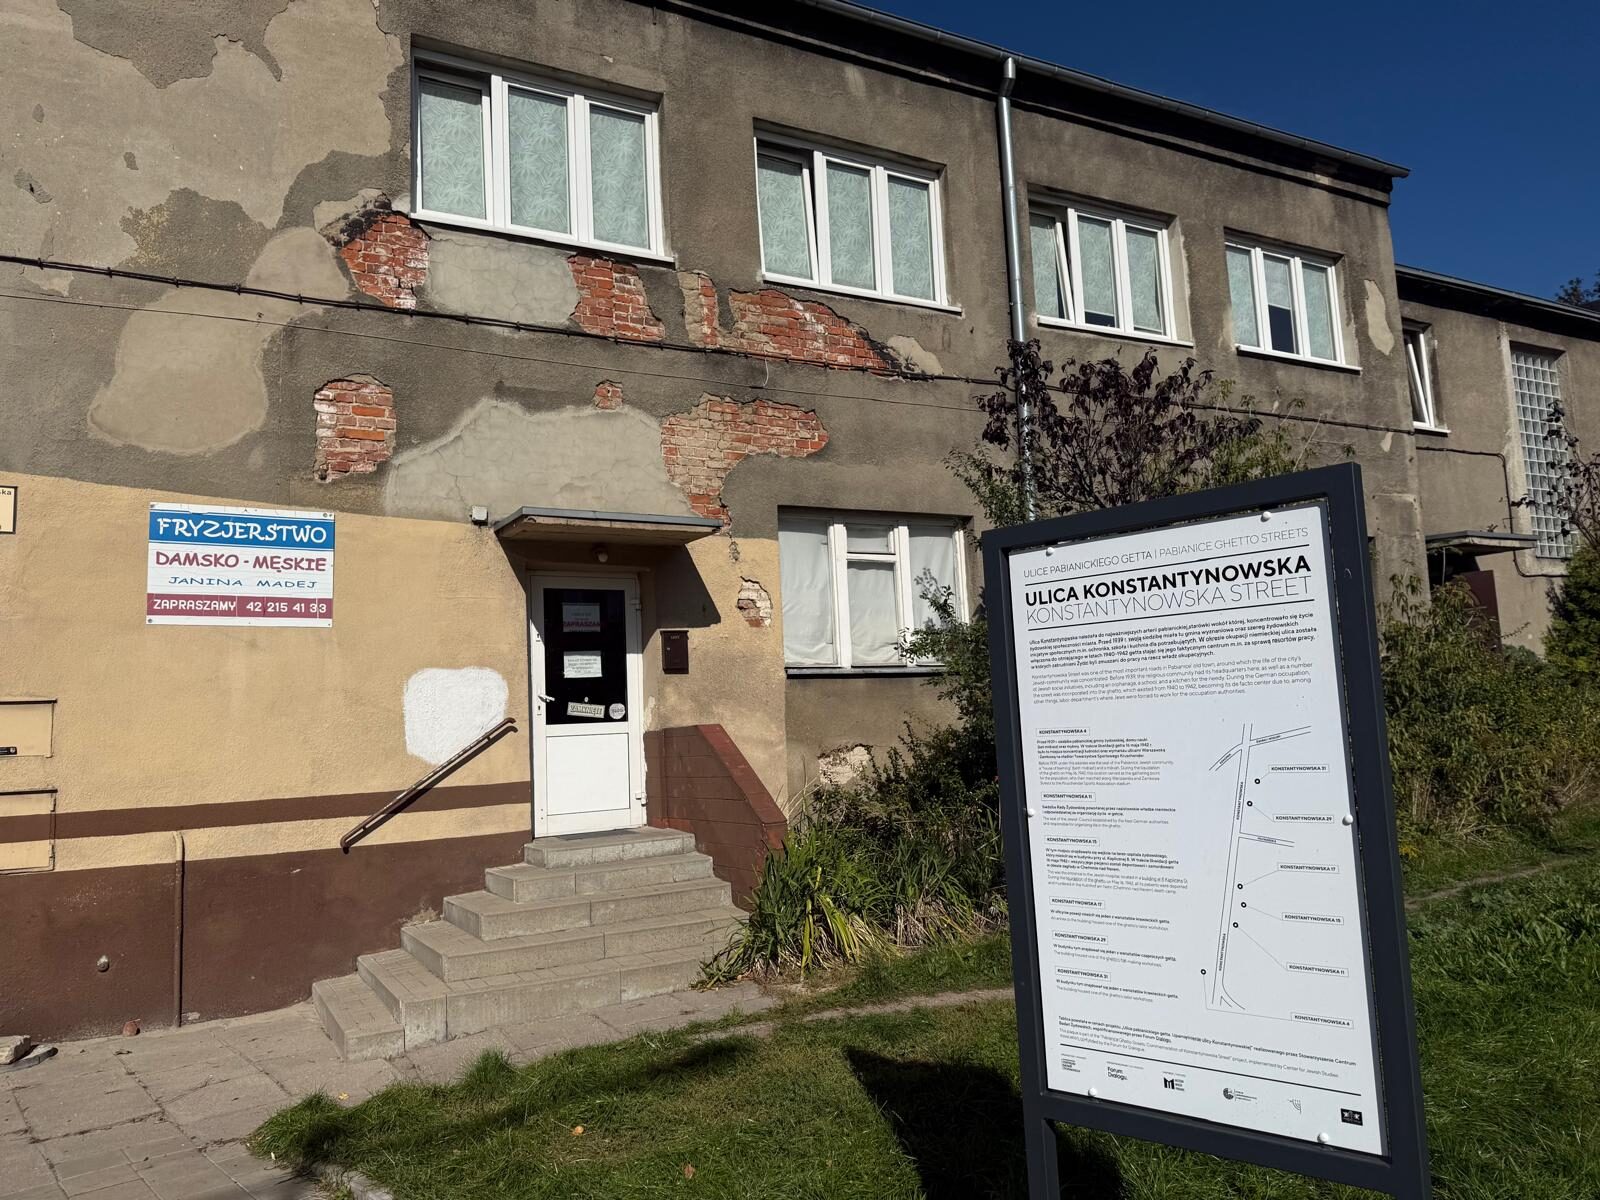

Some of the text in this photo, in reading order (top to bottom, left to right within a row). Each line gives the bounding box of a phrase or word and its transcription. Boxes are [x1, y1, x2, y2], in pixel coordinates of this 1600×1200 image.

[157, 518, 327, 543] FRYZJERSTWO
[1023, 566, 1049, 578] ULICE
[1050, 556, 1120, 574] PABIANICKIEGO
[1121, 551, 1153, 564] GETTA
[1160, 541, 1213, 556] PABIANICE
[1215, 534, 1260, 550] GHETTO
[1261, 527, 1309, 543] STREETS
[156, 551, 239, 568] DAMSKO
[252, 556, 327, 573] MĘSKIE
[168, 576, 318, 589] JANINA MADEJ
[1025, 555, 1312, 607] ULICA KONSTANTYNOWSKA
[153, 599, 327, 613] ZAPRASZAMY 42 215 41 33
[1026, 575, 1312, 625] KONSTANTYNOWSKA STREET
[1051, 898, 1097, 906] KONSTANTYNOWSKA
[1284, 914, 1335, 922] KONSTANTYNOWSKA
[1054, 932, 1100, 942] KONSTANTYNOWSKA
[1057, 968, 1103, 978] KONSTANTYNOWSKA
[1288, 964, 1340, 974] KONSTANTYNOWSKA
[1294, 1014, 1345, 1026] KONSTANTYNOWSKA
